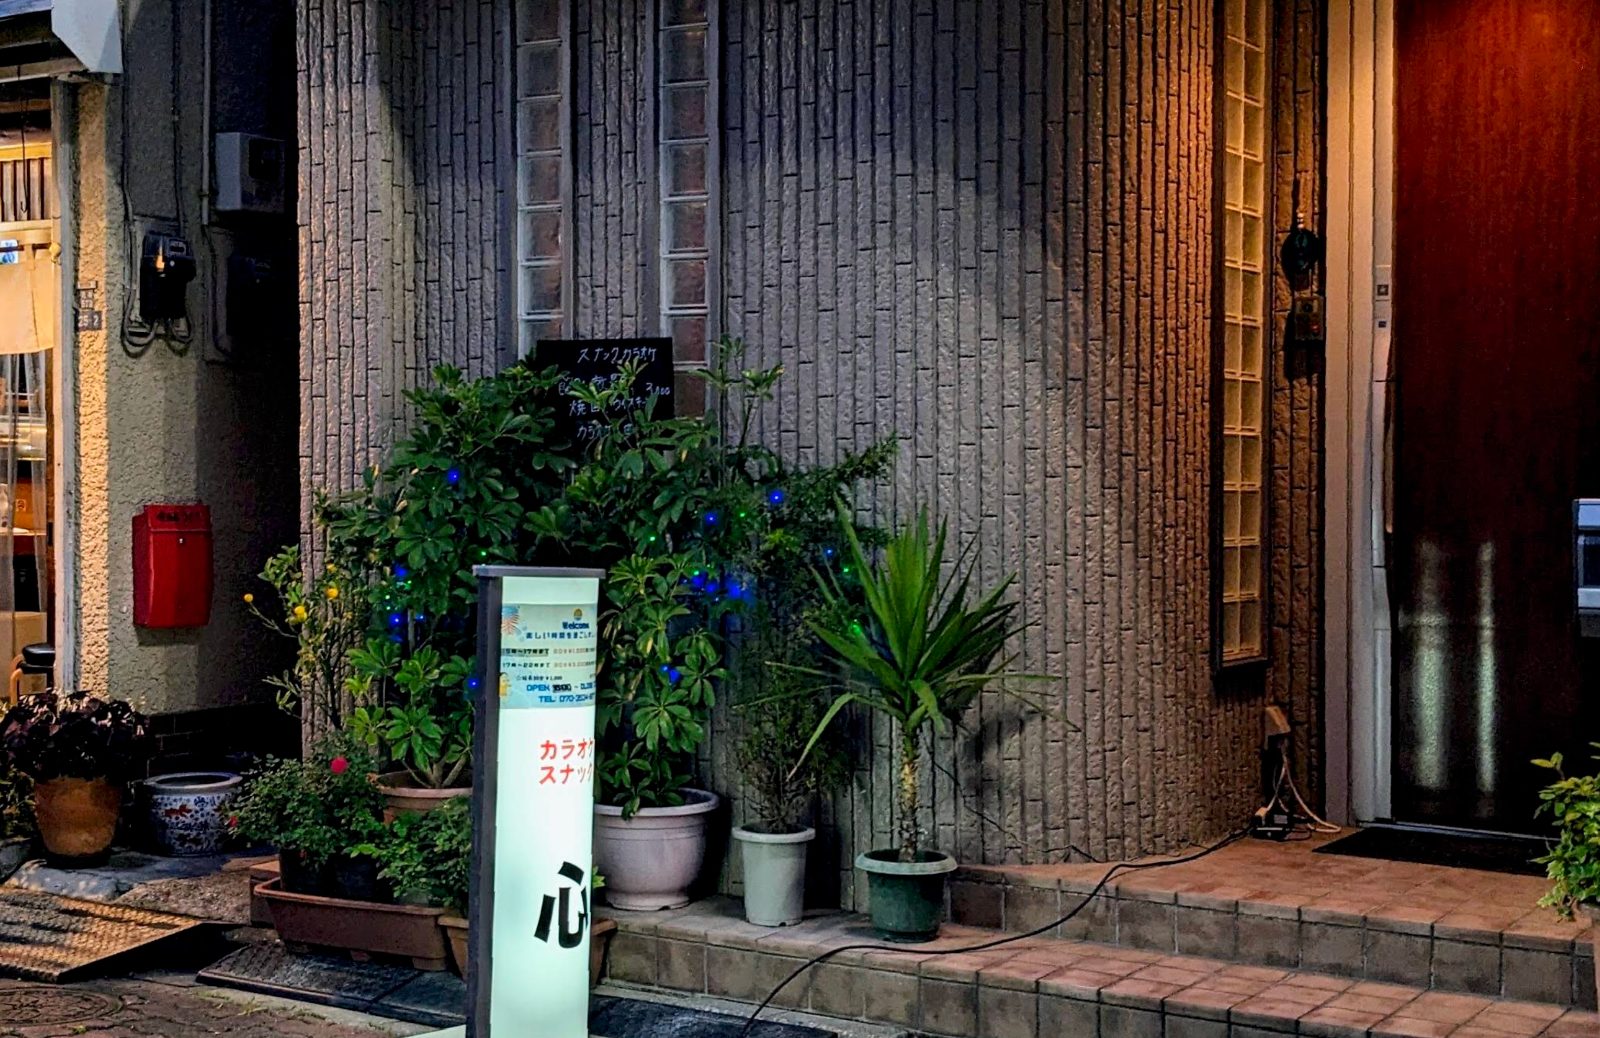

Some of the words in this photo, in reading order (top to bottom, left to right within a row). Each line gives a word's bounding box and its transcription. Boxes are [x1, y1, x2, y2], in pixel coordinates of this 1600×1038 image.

[526, 684, 551, 692] OPEN
[540, 738, 594, 760] カラオケ
[539, 763, 593, 785] スナック
[533, 860, 589, 949] 心
